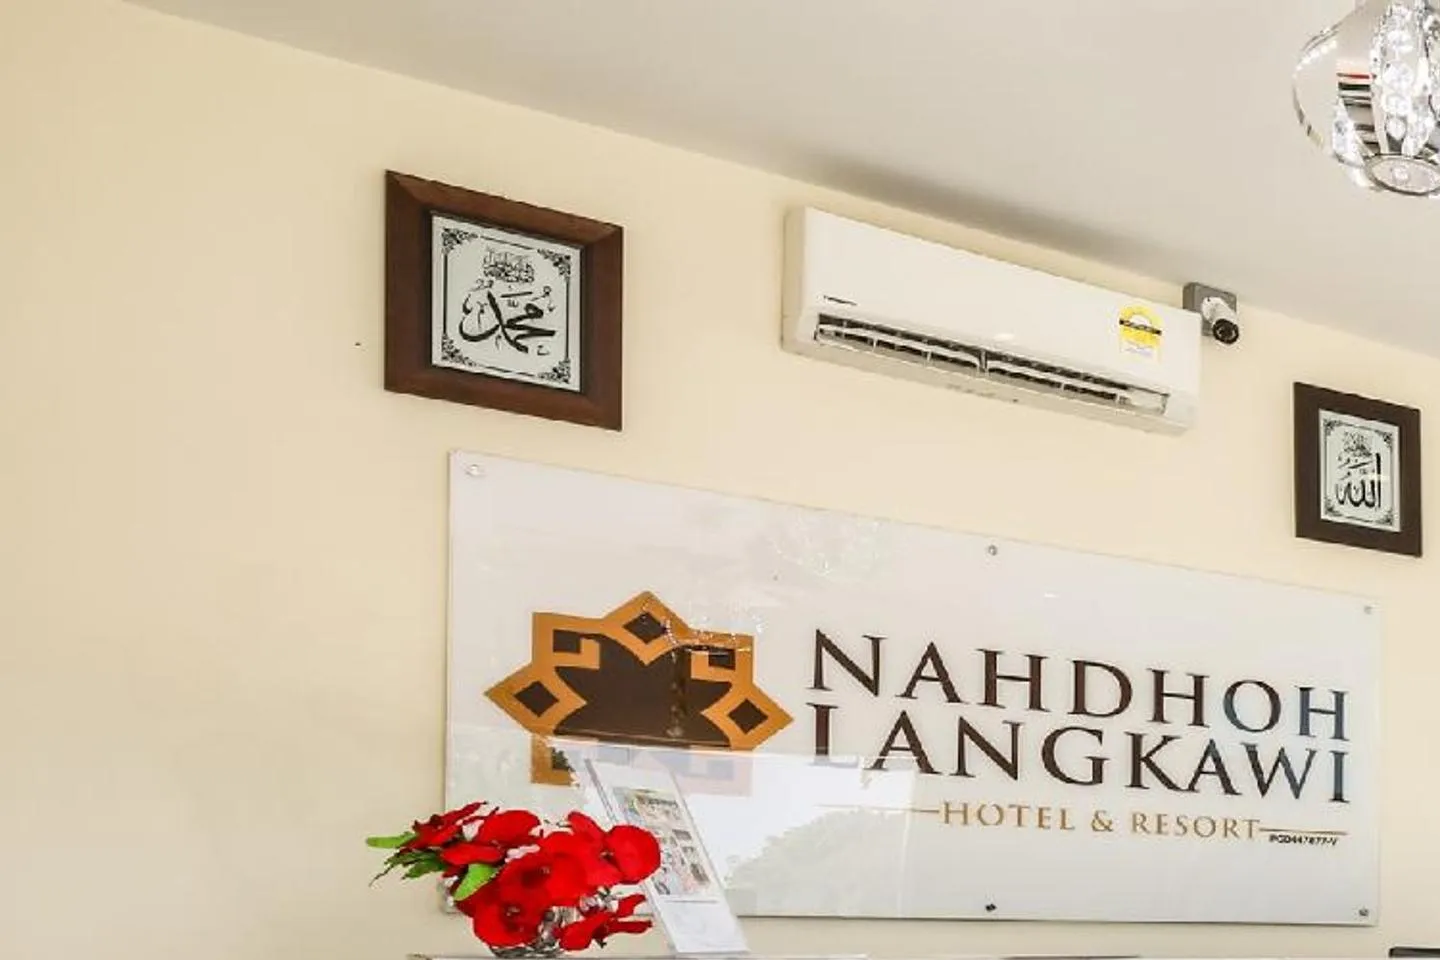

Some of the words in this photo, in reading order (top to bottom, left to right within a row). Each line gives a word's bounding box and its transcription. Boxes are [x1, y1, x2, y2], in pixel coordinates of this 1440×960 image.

[805, 628, 1351, 742] NAHDHOH
[805, 703, 1351, 804] LANGKAWI
[942, 801, 1076, 832] HOTEL
[1090, 810, 1114, 833] &
[1131, 813, 1261, 840] RESORT
